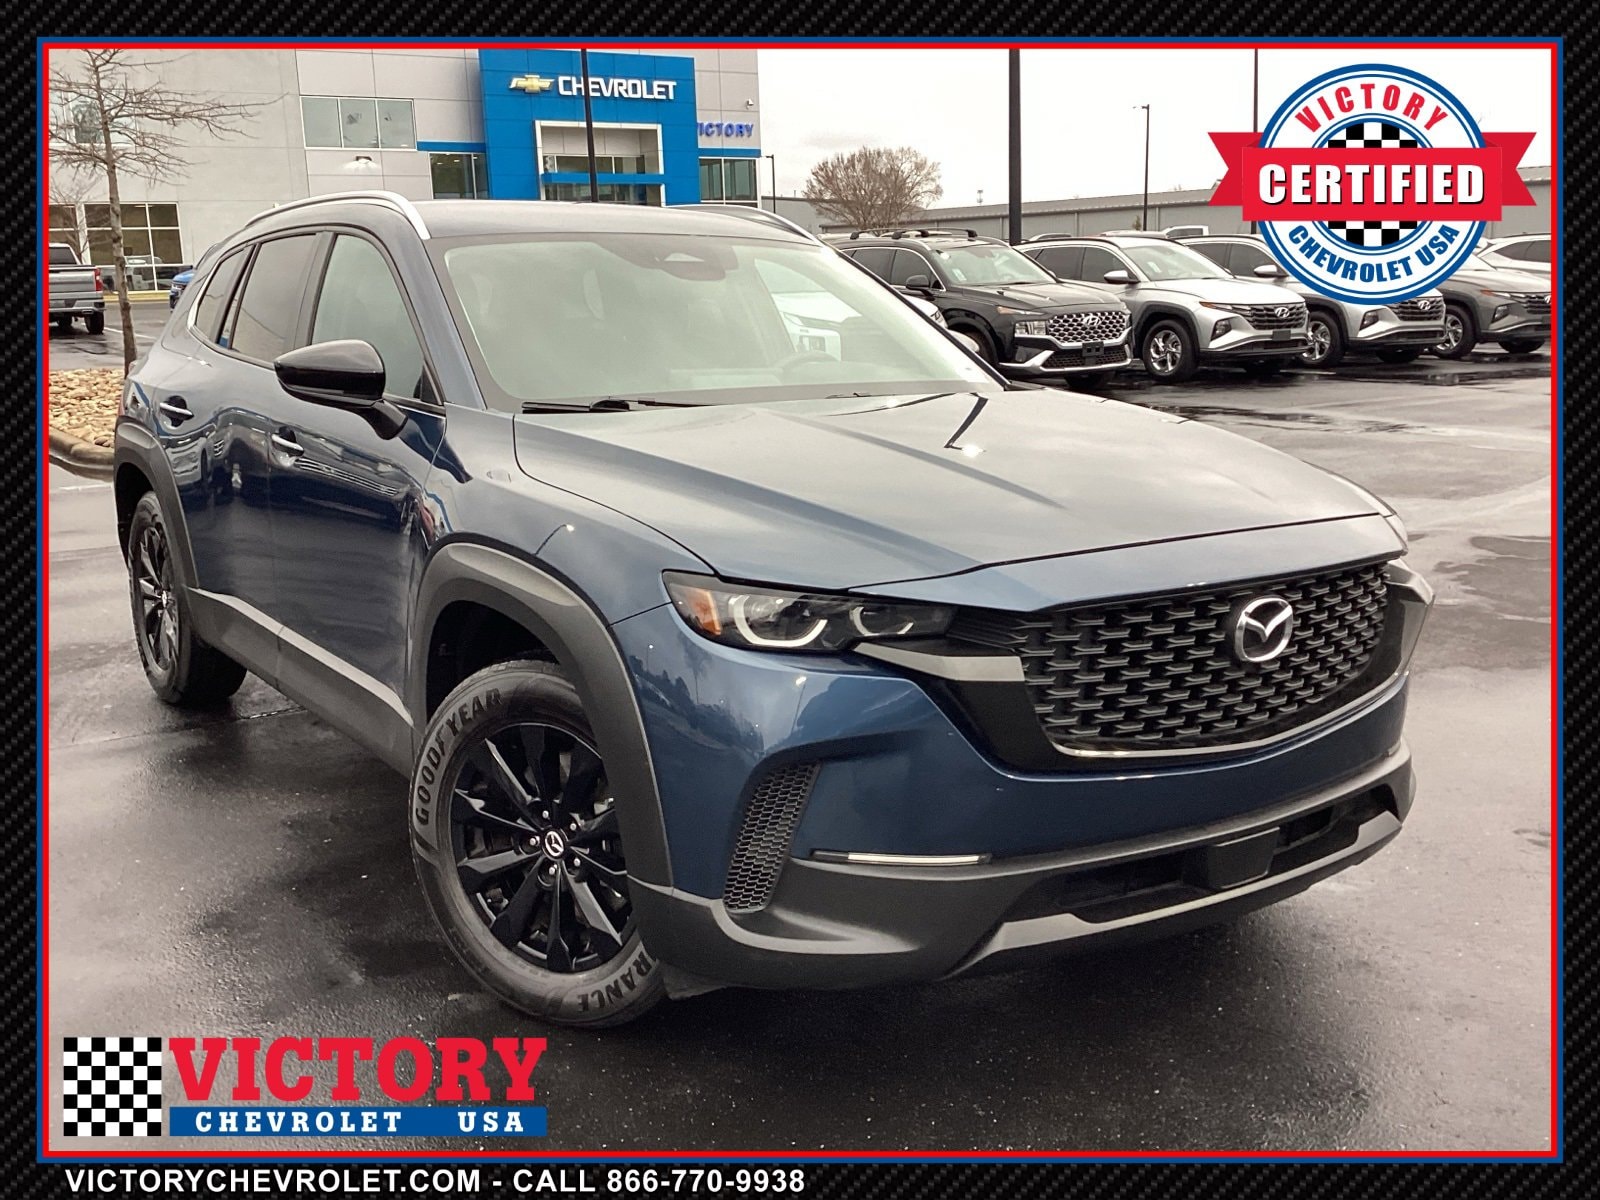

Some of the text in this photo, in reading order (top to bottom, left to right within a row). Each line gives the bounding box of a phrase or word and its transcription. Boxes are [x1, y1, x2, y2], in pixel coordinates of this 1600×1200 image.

[558, 75, 678, 101] CHEVROLET
[697, 122, 754, 138] ICTORY
[415, 687, 503, 826] GOODYEAR
[577, 950, 653, 1012] RANCE
